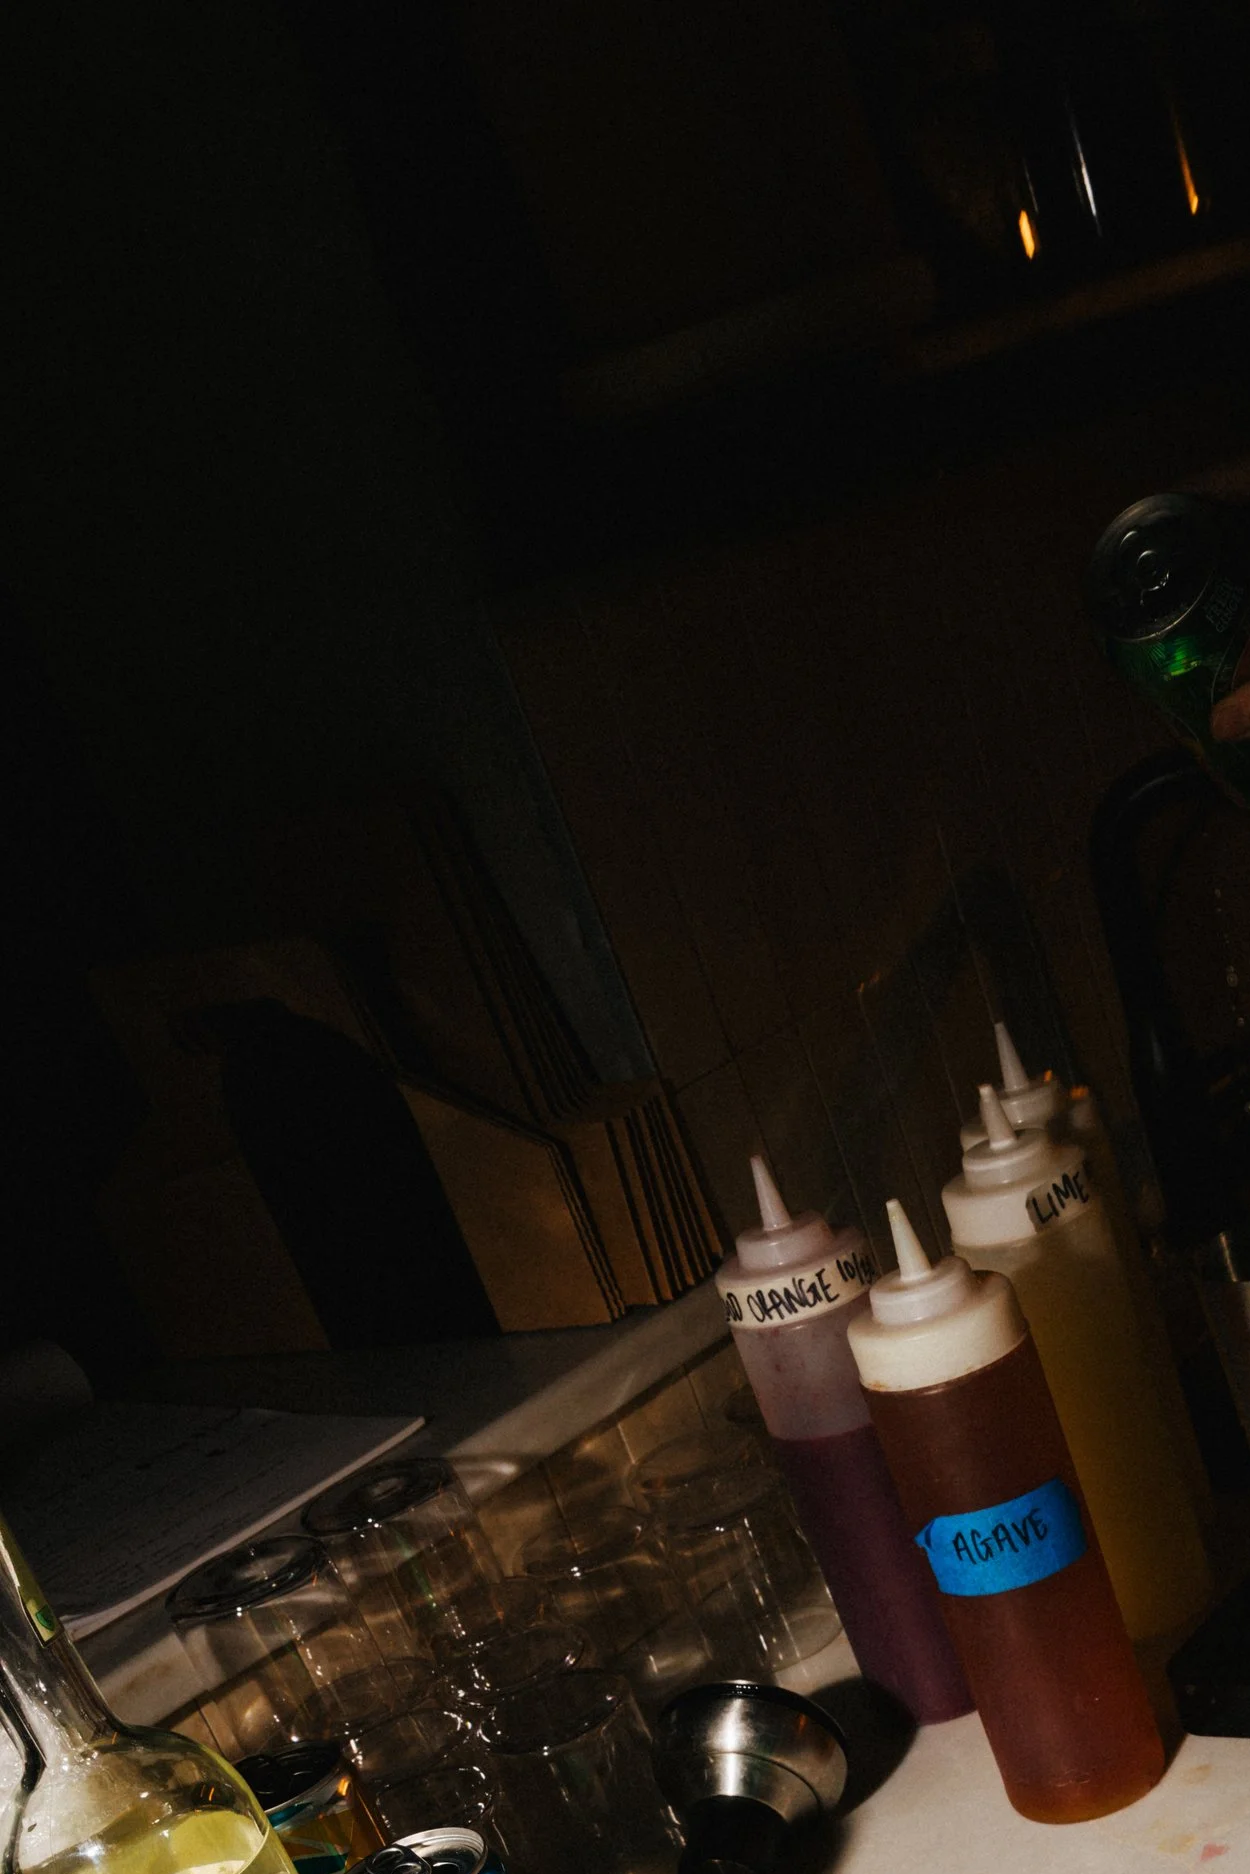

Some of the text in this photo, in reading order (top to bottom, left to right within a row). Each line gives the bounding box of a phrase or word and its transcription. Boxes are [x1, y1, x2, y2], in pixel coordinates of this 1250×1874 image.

[1032, 1171, 1089, 1224] LIME
[747, 1268, 840, 1323] ORANGE
[952, 1507, 1048, 1565] AGAVE
